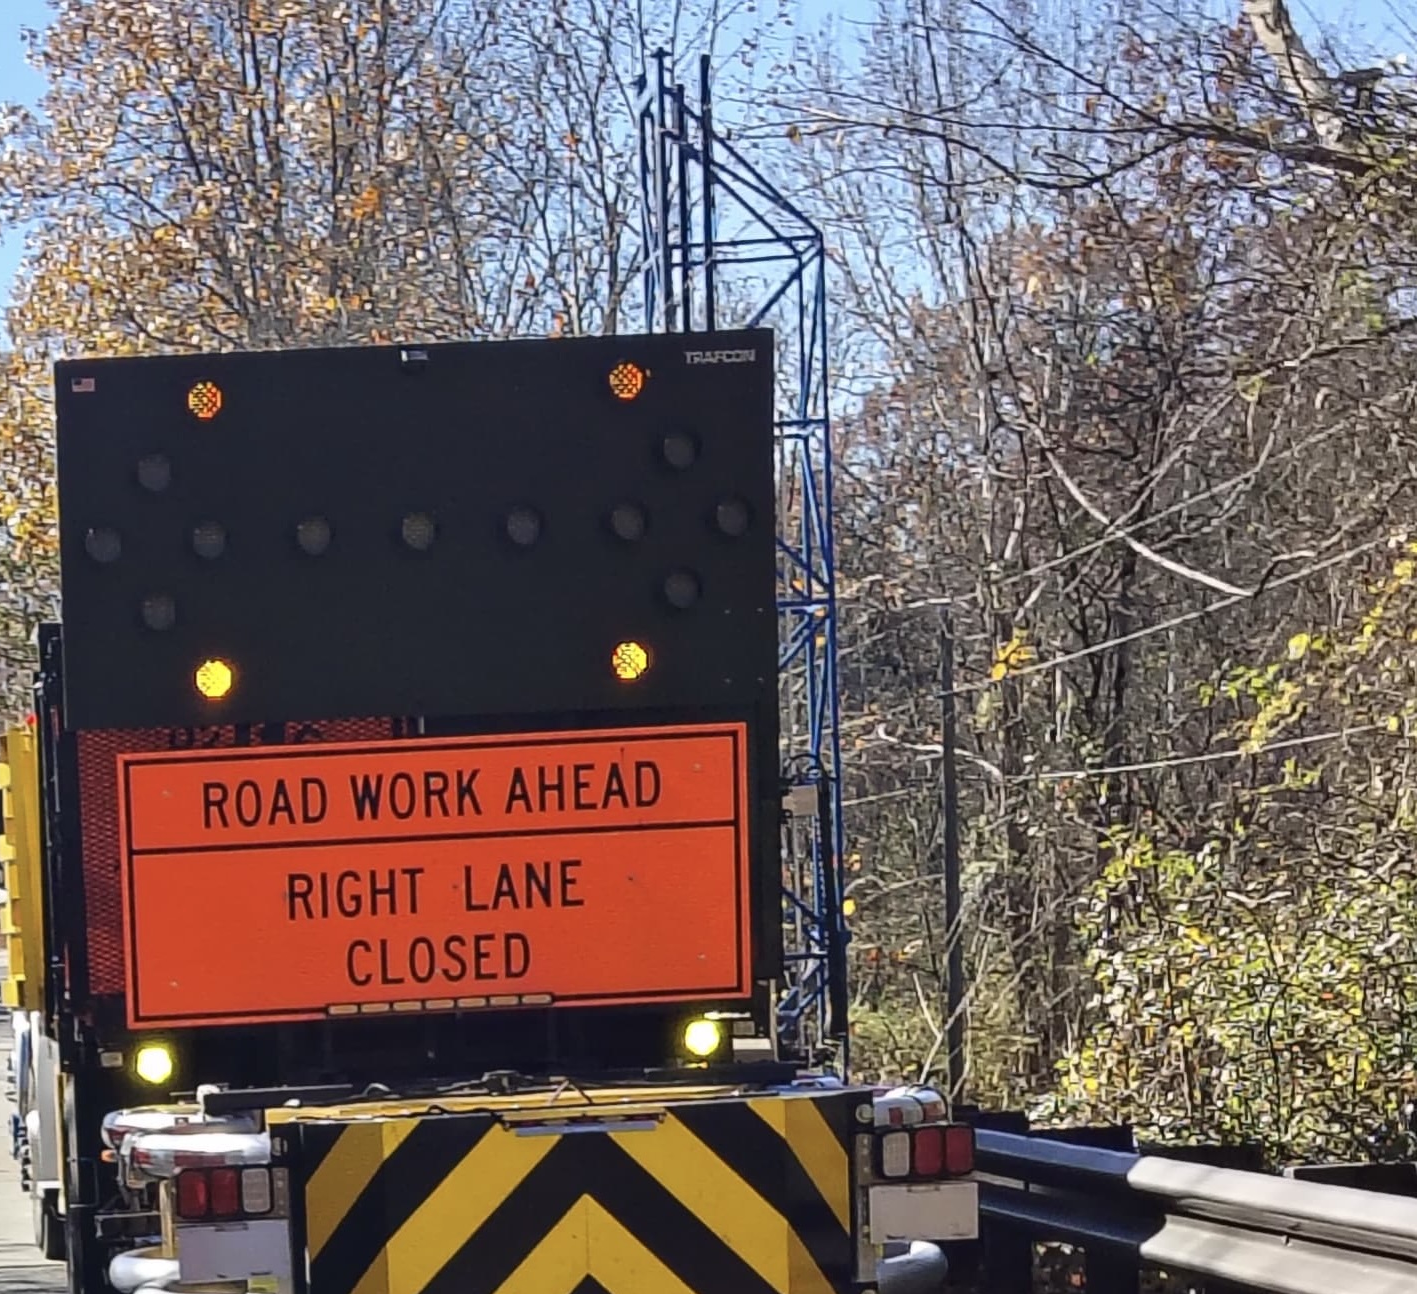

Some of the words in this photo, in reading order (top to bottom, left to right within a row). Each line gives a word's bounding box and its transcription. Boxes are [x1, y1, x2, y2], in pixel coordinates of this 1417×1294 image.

[684, 348, 756, 365] TRAFCON
[202, 776, 328, 830] ROAD
[349, 768, 483, 822] WORK
[504, 760, 662, 815] AHEAD
[286, 867, 425, 921] RIGHT
[463, 859, 585, 912] LANE
[346, 931, 532, 987] CLOSED
